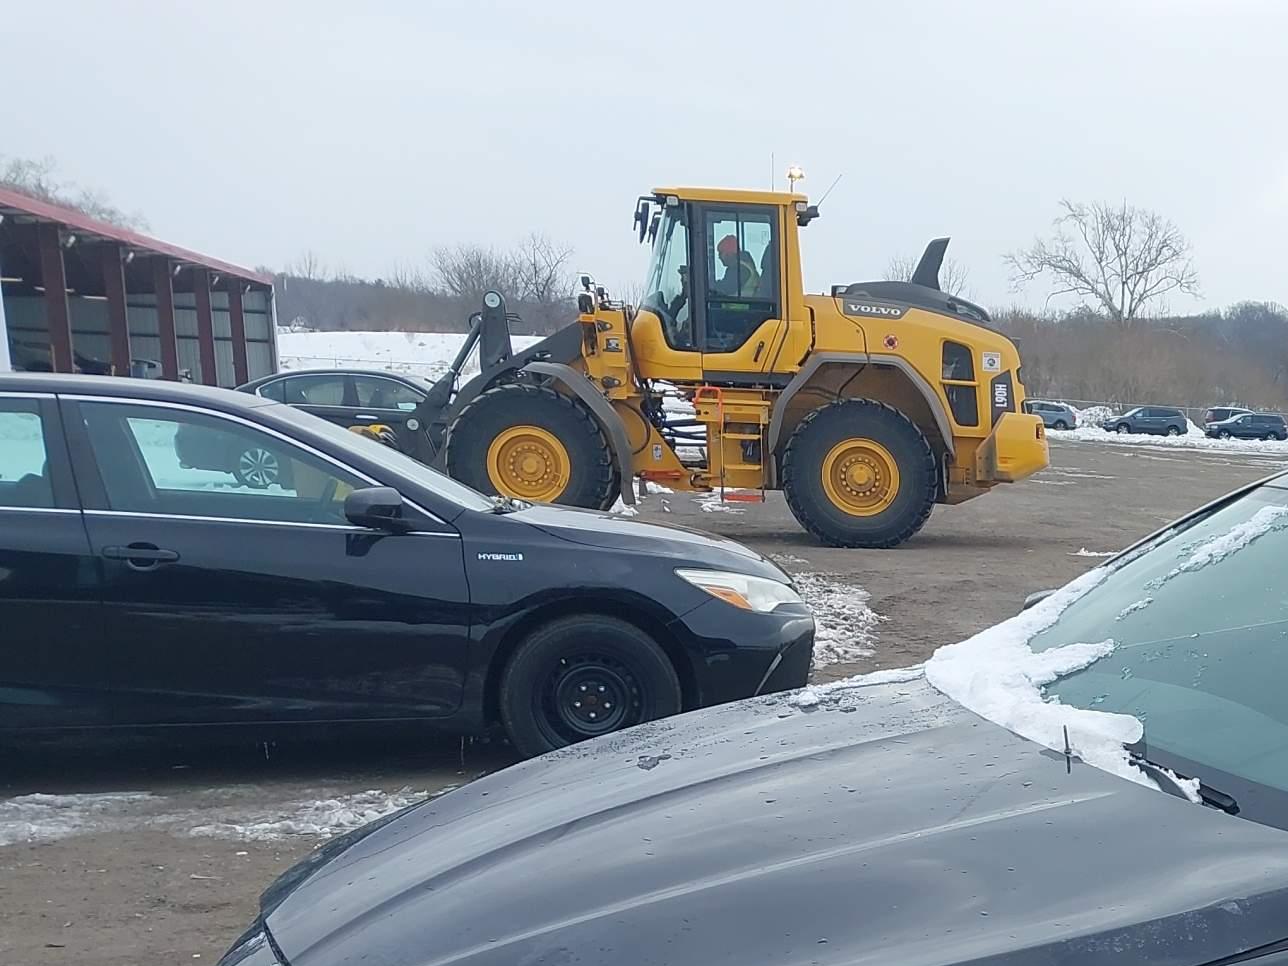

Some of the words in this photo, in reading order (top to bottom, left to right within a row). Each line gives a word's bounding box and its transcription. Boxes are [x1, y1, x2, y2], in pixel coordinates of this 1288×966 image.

[849, 304, 901, 316] VOLVO
[995, 383, 1008, 408] L90H
[478, 553, 517, 561] HYBRID
